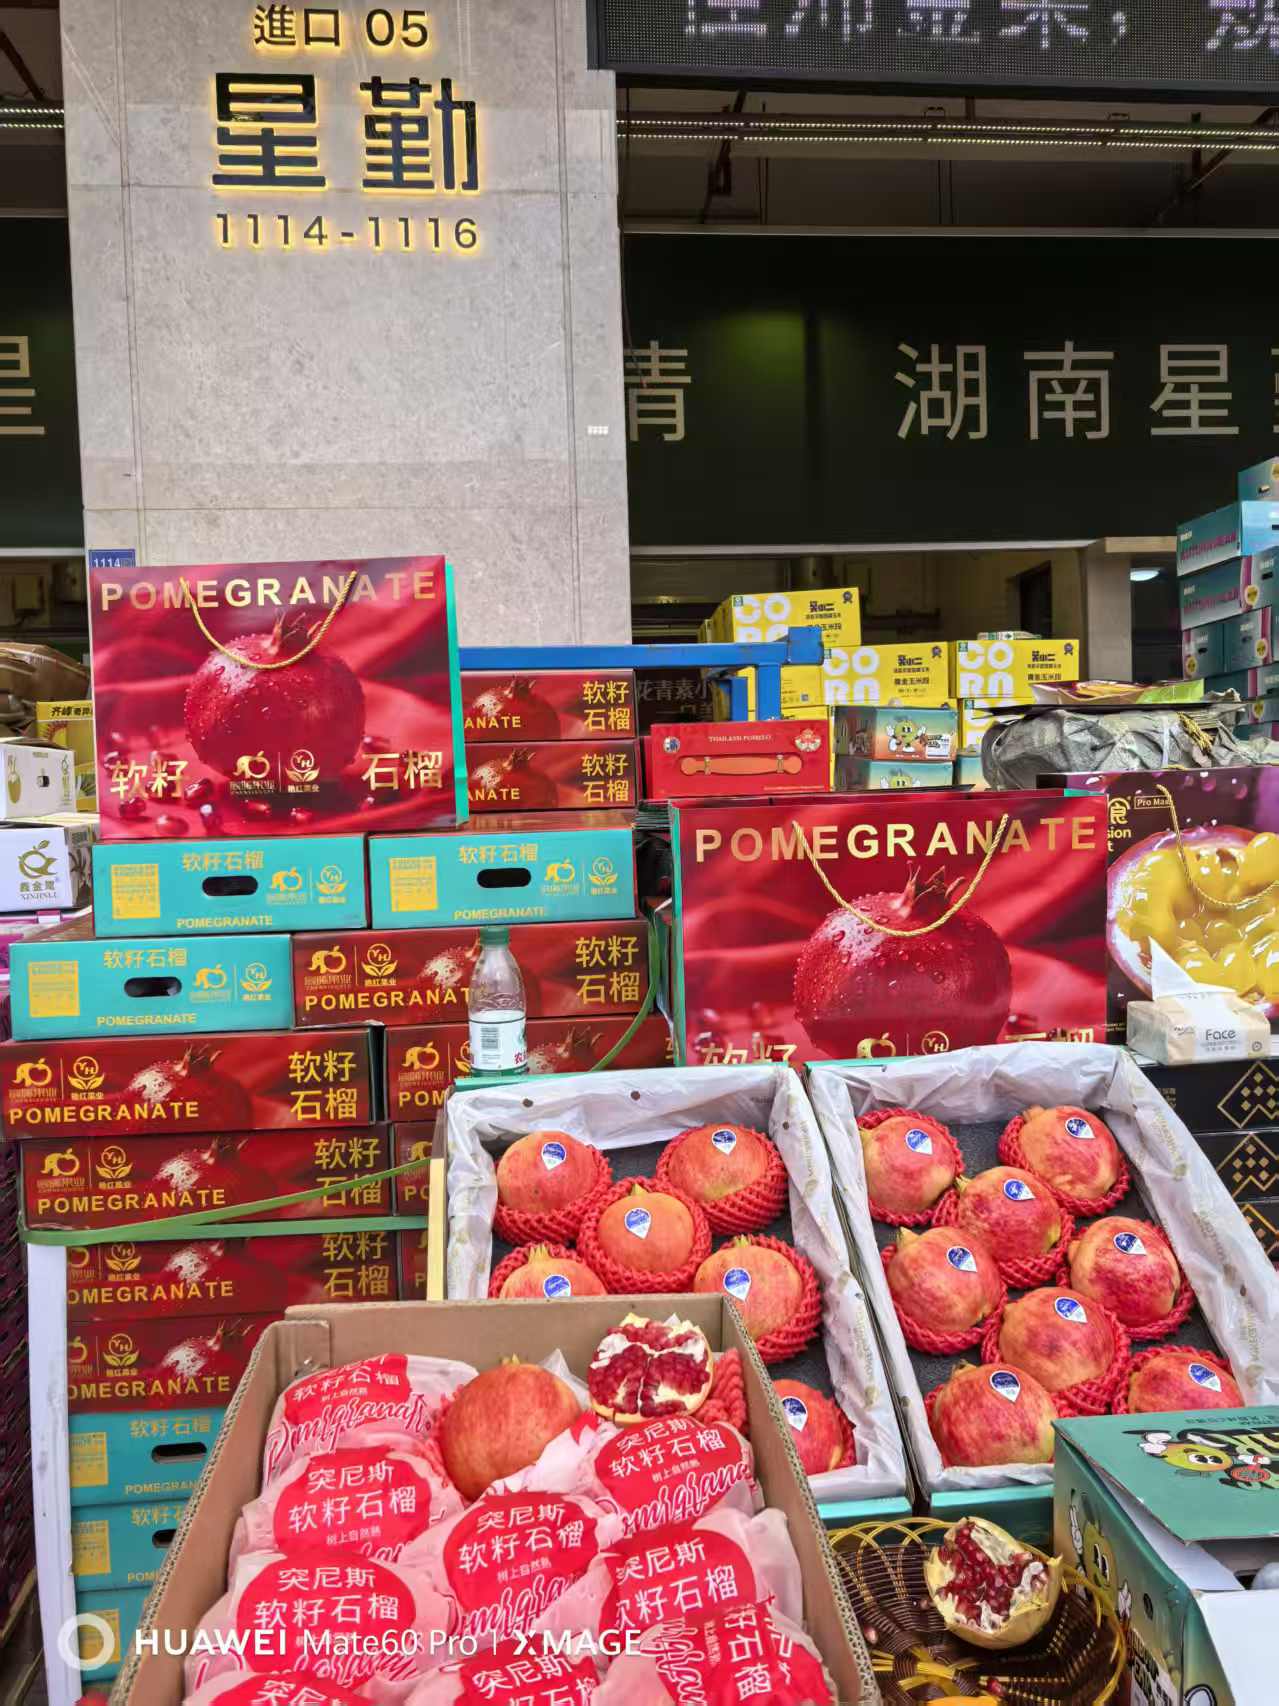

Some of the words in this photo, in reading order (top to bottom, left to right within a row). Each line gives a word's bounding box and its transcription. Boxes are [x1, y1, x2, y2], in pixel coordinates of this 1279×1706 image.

[254, 5, 342, 48] 進口
[364, 11, 430, 48] 05
[212, 73, 480, 191] 星勤
[216, 213, 478, 250] 1114-1116
[894, 340, 1279, 442] 湖南星
[101, 570, 436, 612] POMEGRANATE
[583, 680, 630, 705] 软籽
[584, 708, 630, 731] 石榴
[109, 760, 189, 800] 软籽
[360, 750, 443, 792] 石榴
[581, 752, 629, 777] 软籽
[583, 780, 629, 803] 石榴
[458, 844, 539, 864] 软籽石榴
[695, 815, 1096, 863] POMEGRANATE
[182, 851, 264, 872] 软籽石榴
[176, 914, 273, 929] POMEGRANATE
[453, 906, 545, 921] POMEGRANATE
[103, 947, 187, 969] 软籽石榴
[575, 935, 639, 968] 软籽
[304, 986, 480, 1012] POMEGRANAT
[576, 972, 640, 1004] 石榴
[96, 1012, 197, 1028] POMEGRANATE
[1205, 1028, 1237, 1041] Face
[288, 1050, 357, 1084] 软籽
[9, 1101, 200, 1125] POMEGRANATE
[289, 1087, 358, 1121] 石榴
[314, 1137, 381, 1170] 软籽
[38, 1188, 225, 1215] POMEGRANATE
[322, 1232, 388, 1262] 软籽
[323, 1264, 390, 1298] 石榴
[293, 1366, 400, 1402] 软籽石榴
[129, 1416, 211, 1438] 软籽石榴
[616, 1418, 696, 1454] 突尼斯
[608, 1428, 727, 1478] 软籽石榴
[307, 1460, 395, 1494] 突尼斯
[288, 1485, 417, 1534] 软籽石榴
[476, 1503, 566, 1534] 突尼斯
[458, 1519, 585, 1575] 软籽石榴
[615, 1537, 707, 1586] 突尼斯
[279, 1566, 377, 1592] 突尼斯
[253, 1594, 399, 1630] 软籽石榴
[472, 1654, 573, 1699] 突尼斯
